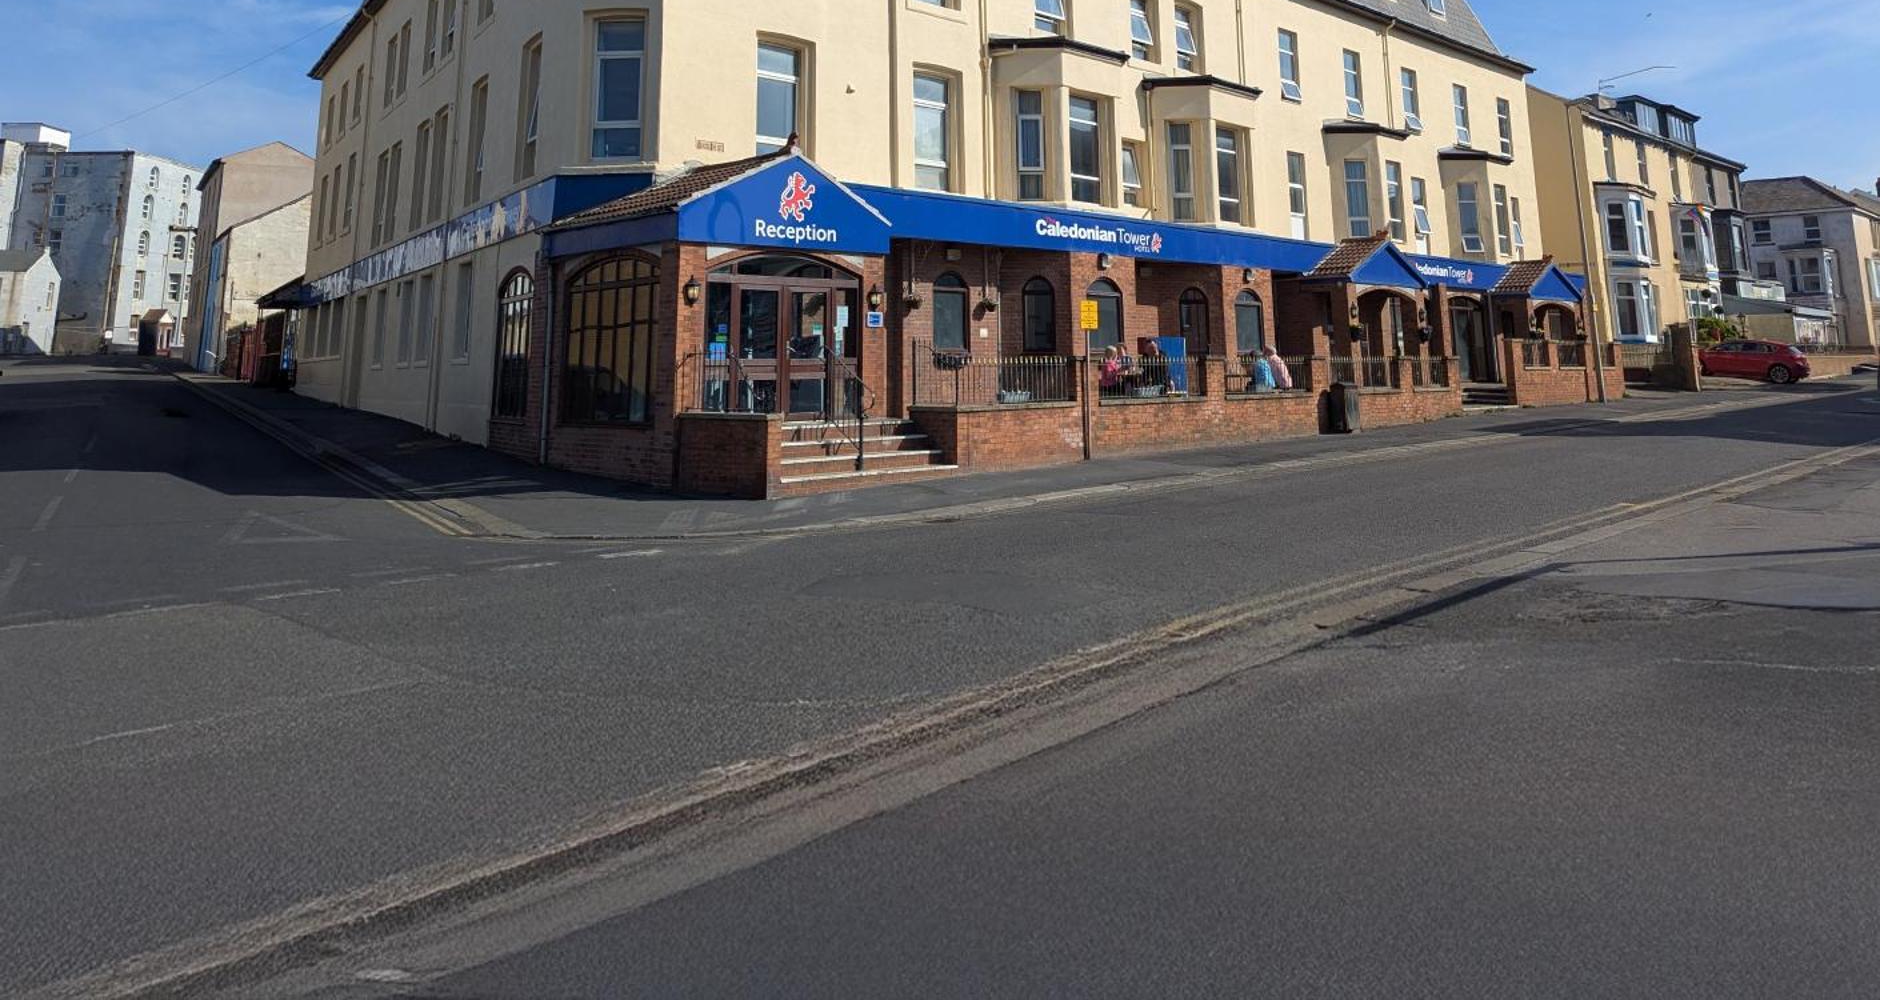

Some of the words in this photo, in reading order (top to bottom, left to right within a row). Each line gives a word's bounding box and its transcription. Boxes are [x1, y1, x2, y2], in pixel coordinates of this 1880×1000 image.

[755, 218, 837, 244] Reception
[1036, 219, 1116, 243] Caledonian
[1116, 228, 1151, 246] Tower
[1415, 262, 1449, 278] ledonian
[1448, 266, 1467, 278] Tower
